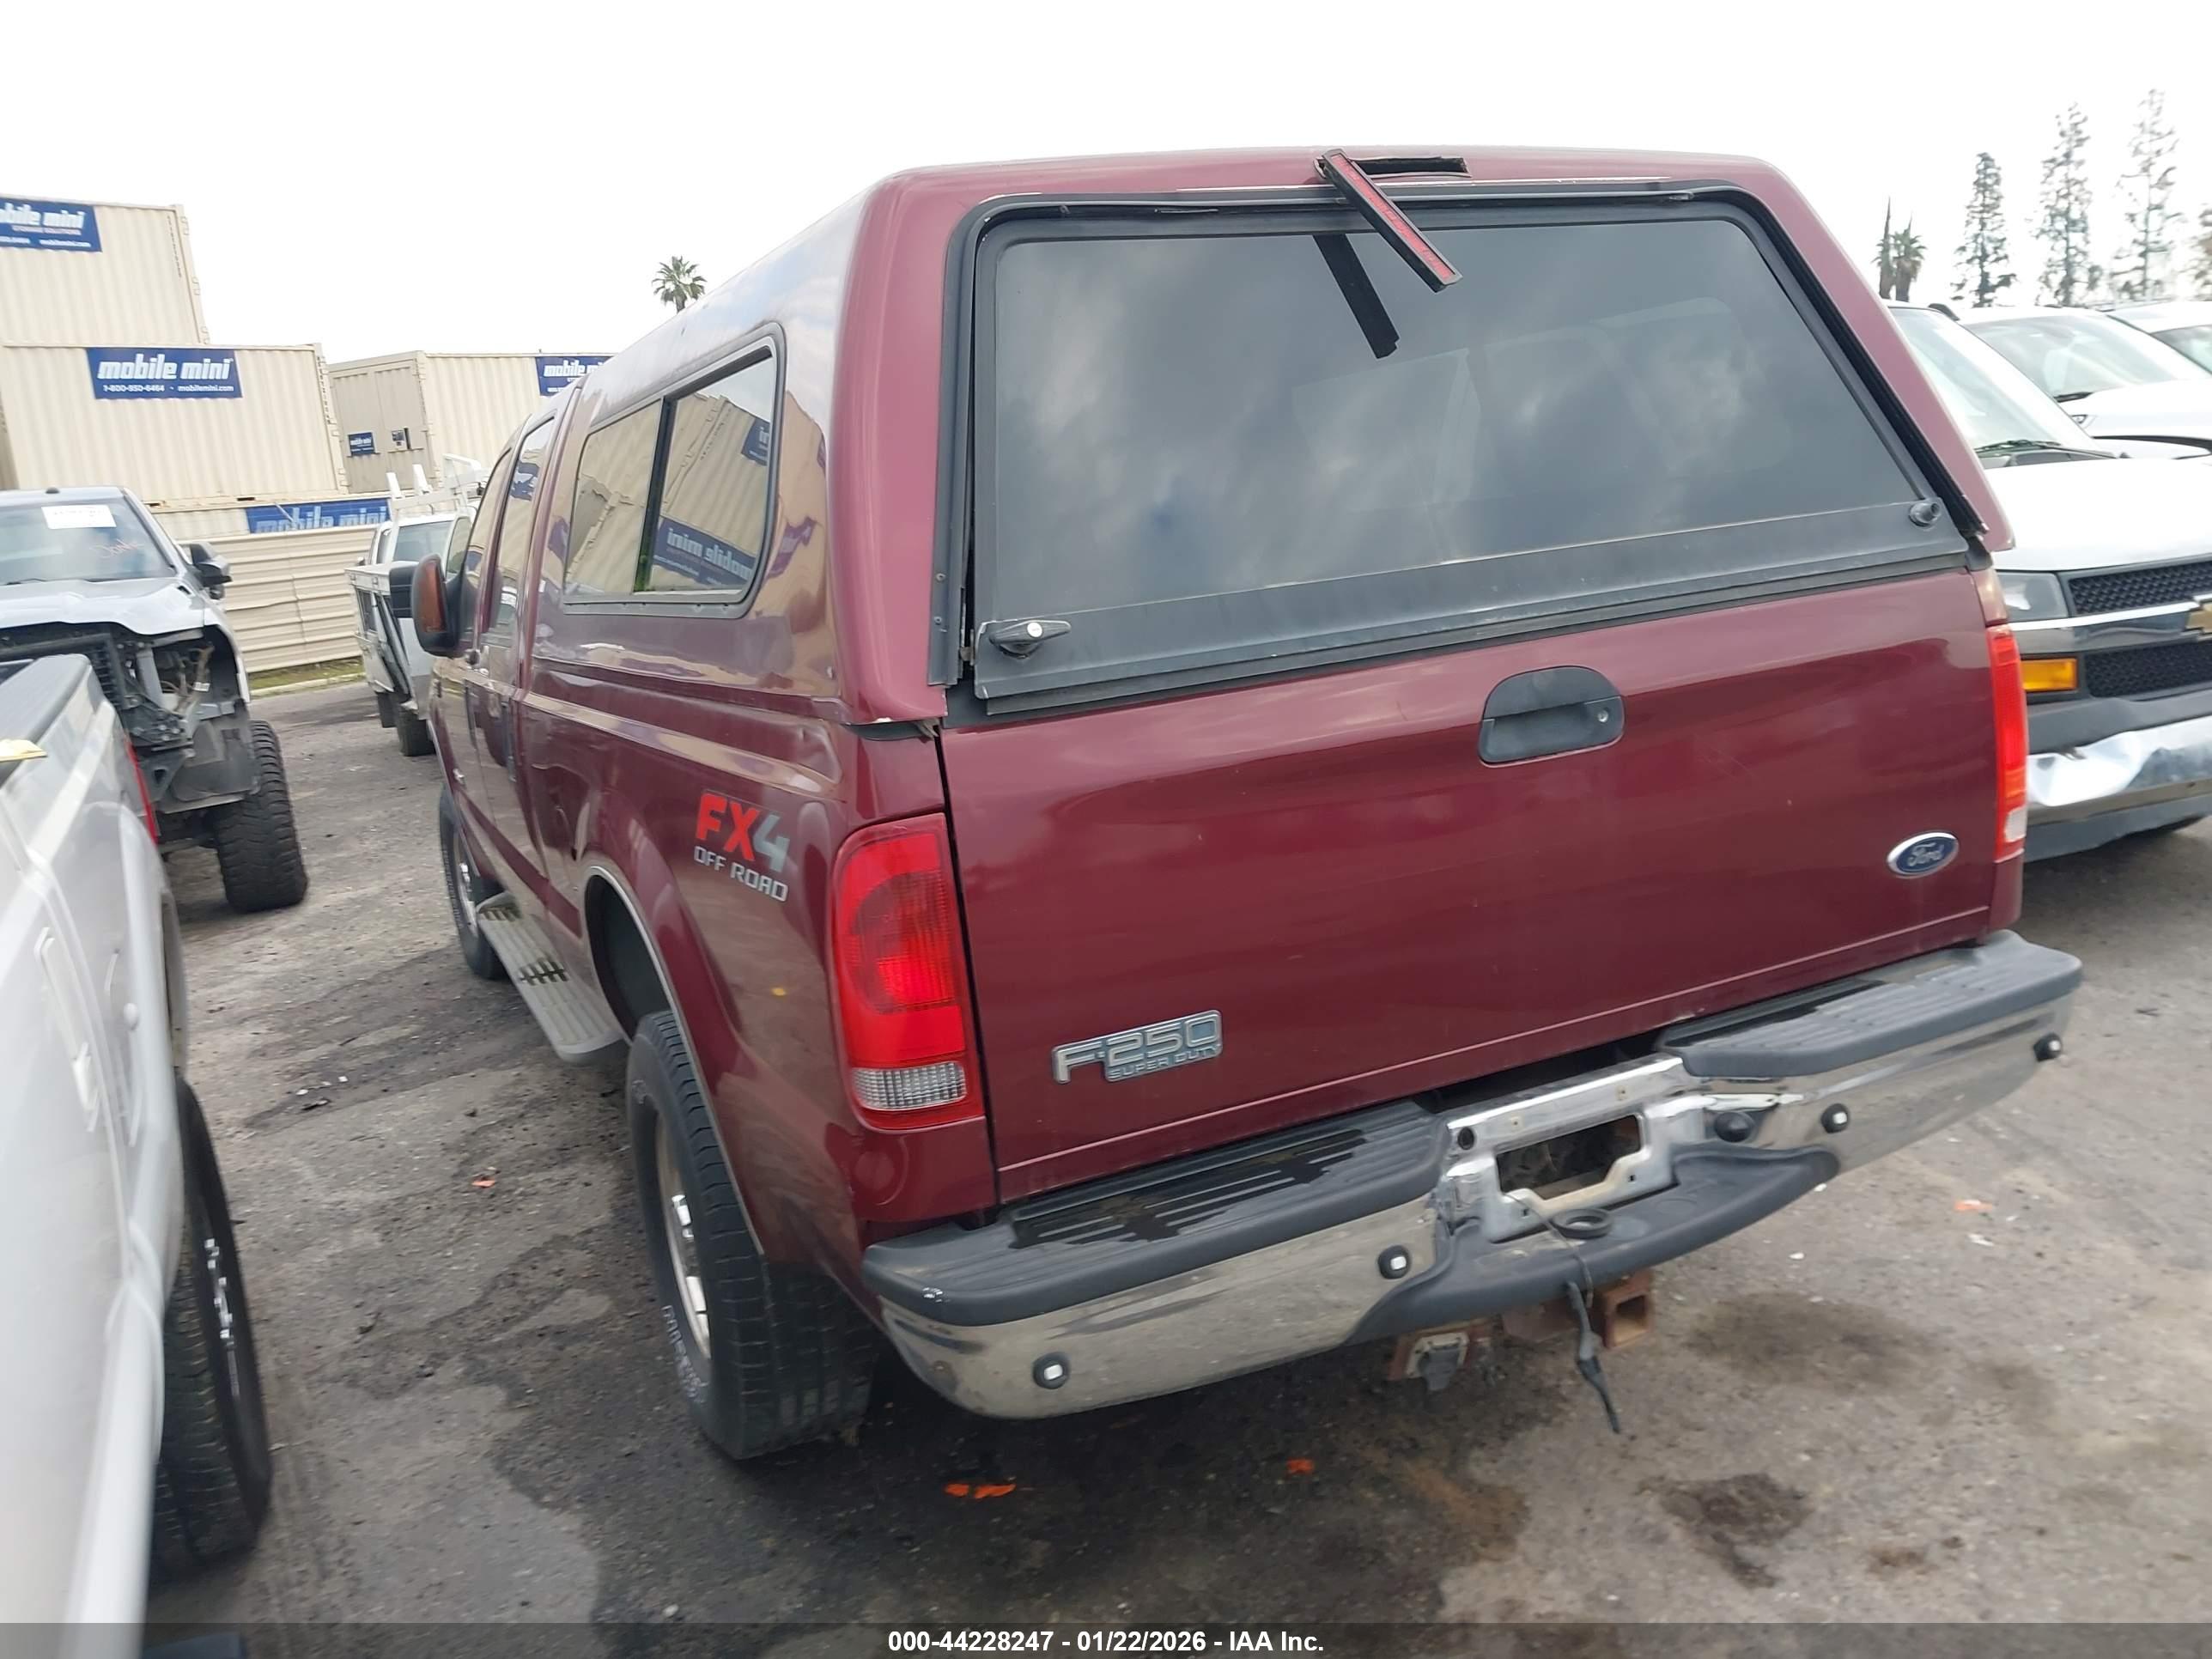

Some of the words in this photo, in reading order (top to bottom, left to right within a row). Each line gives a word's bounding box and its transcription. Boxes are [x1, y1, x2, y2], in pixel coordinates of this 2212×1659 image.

[43, 210, 85, 229] mini
[97, 353, 178, 380] mobile
[180, 358, 231, 380] mini
[544, 359, 586, 377] mobile
[696, 793, 790, 873] FX4
[1907, 842, 1945, 867] Ford
[694, 845, 726, 872] OFF
[730, 861, 789, 902] ROAD
[1109, 1056, 1170, 1080] SUPER
[1175, 1043, 1222, 1063] DUTY
